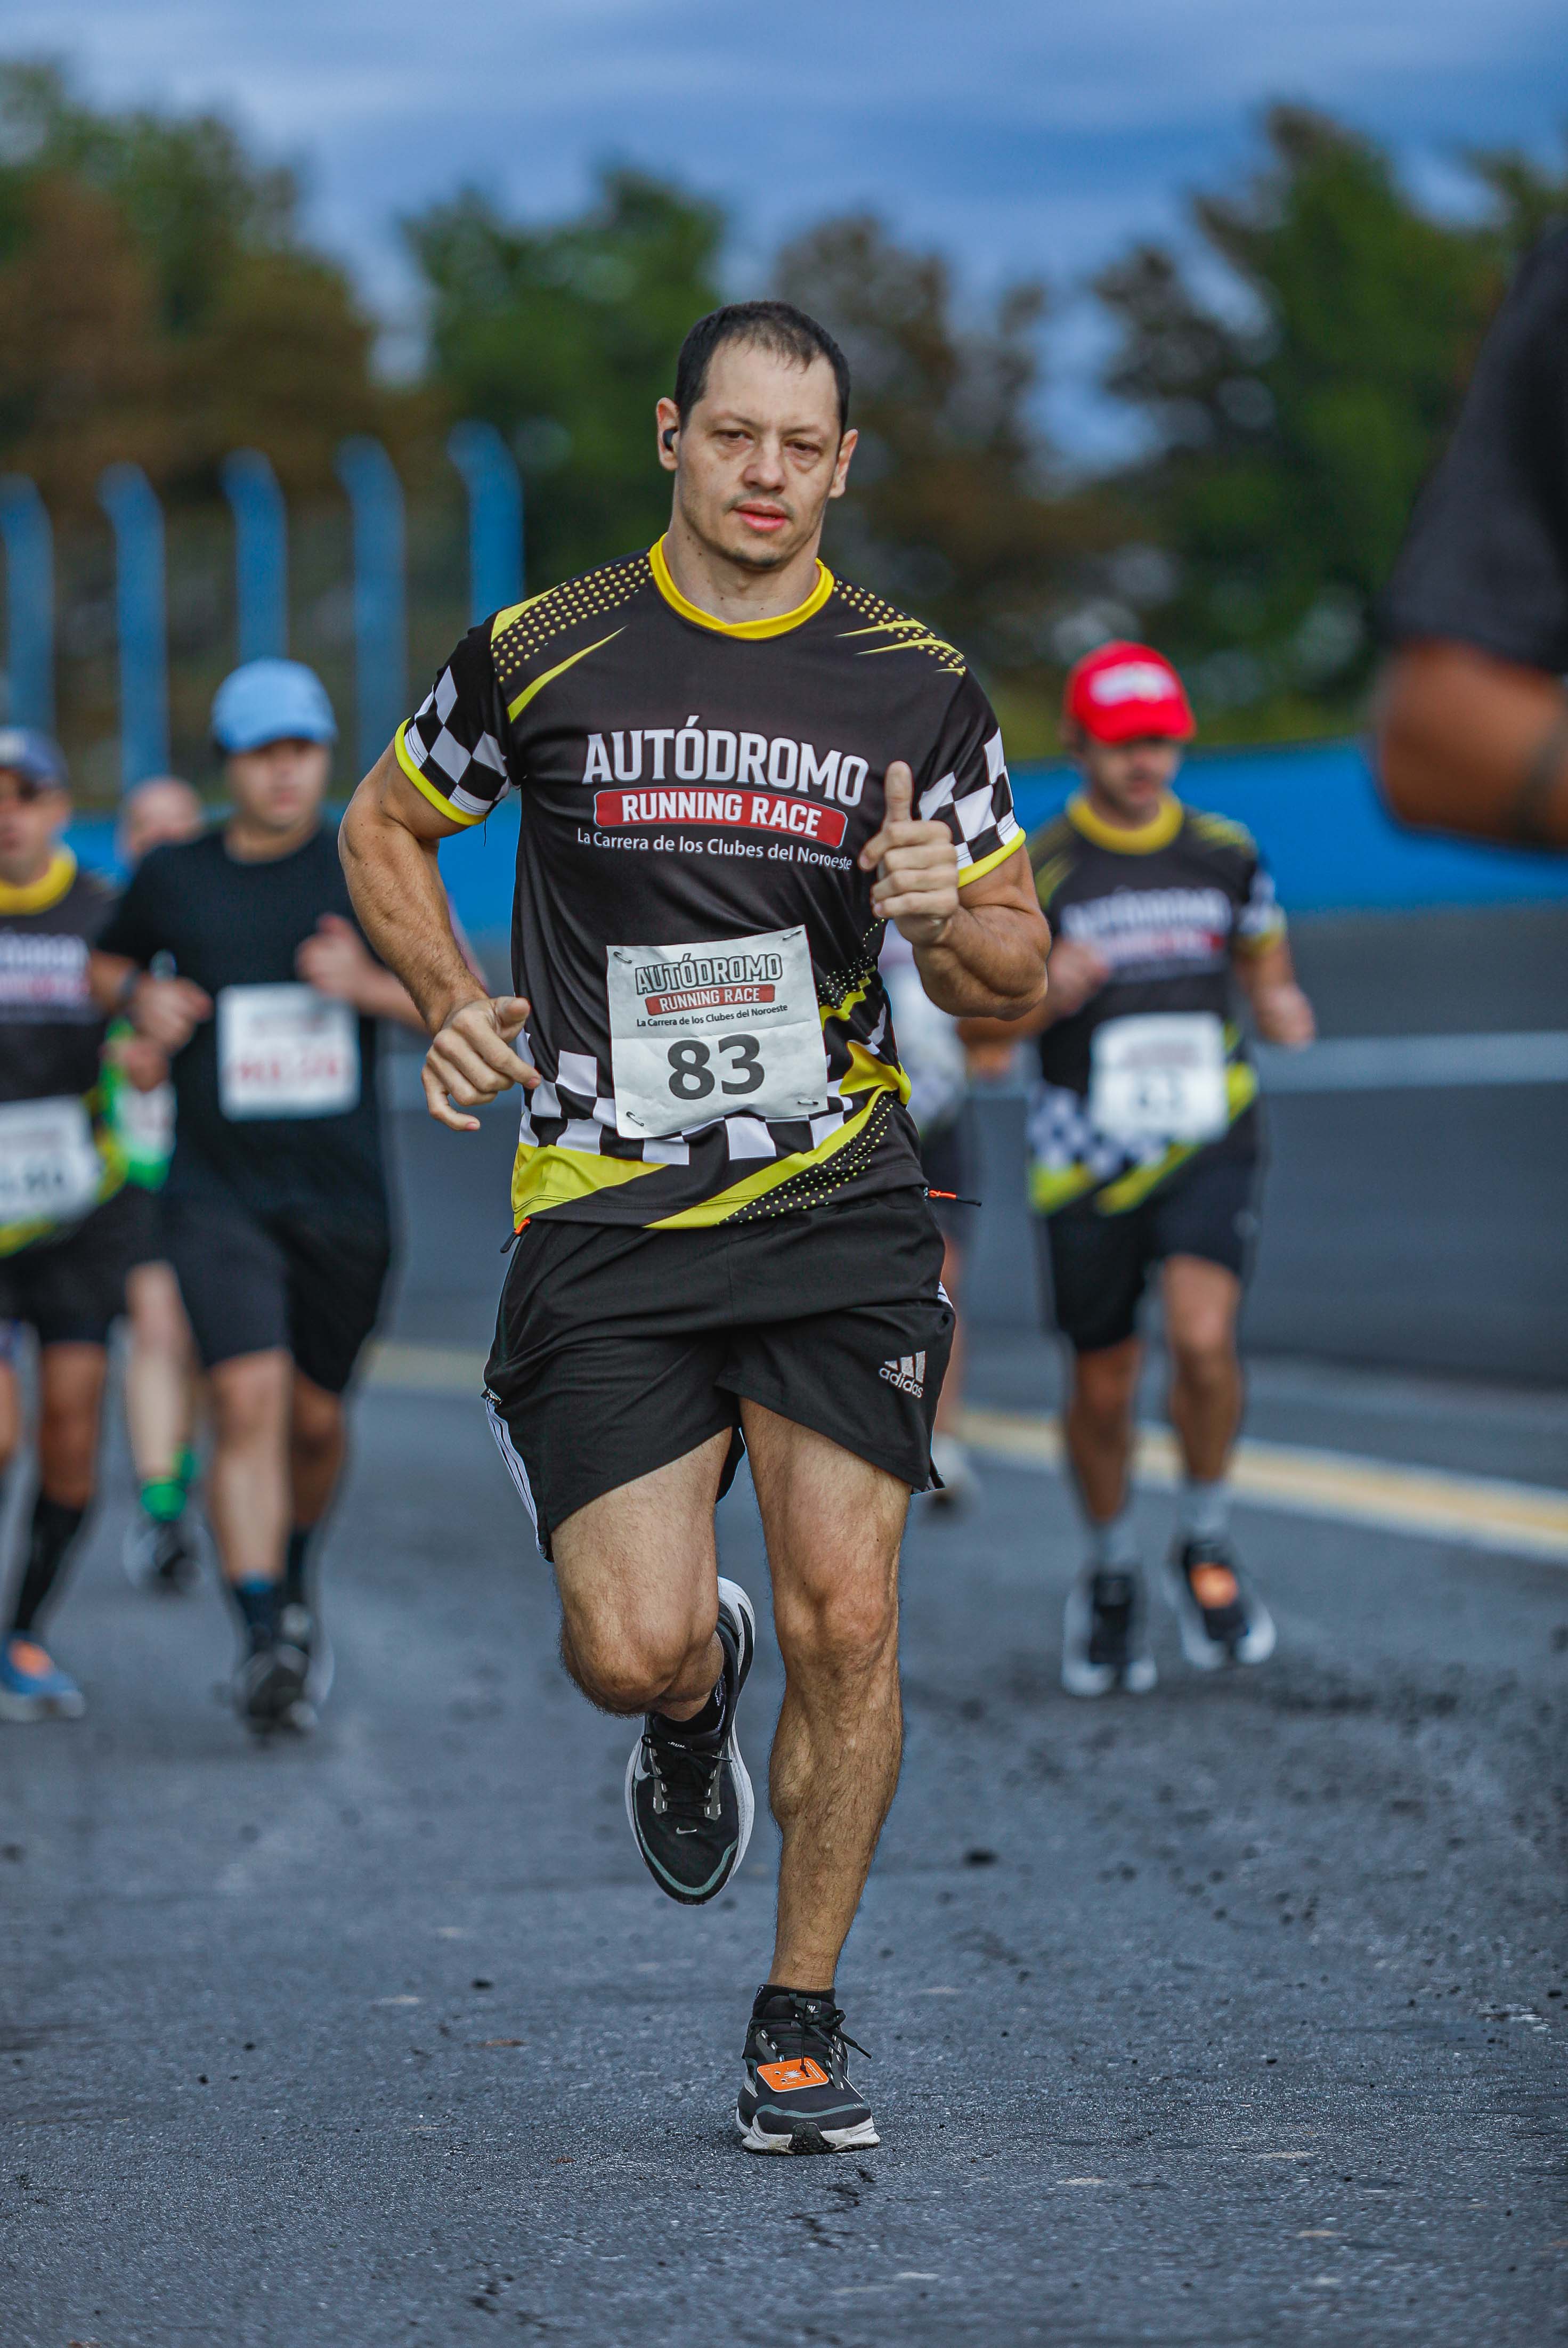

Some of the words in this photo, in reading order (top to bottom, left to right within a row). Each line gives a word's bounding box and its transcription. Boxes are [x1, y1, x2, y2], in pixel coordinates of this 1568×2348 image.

[582, 715, 870, 807] AUTÓDROMO
[621, 792, 742, 822] RUNNING
[751, 796, 822, 837] RACE
[578, 827, 591, 844] La
[593, 832, 648, 851] Carrera
[653, 835, 675, 851] de
[679, 835, 703, 854] los
[707, 838, 764, 858] Clubes
[768, 843, 794, 862] del
[797, 847, 852, 870] Noroeste
[635, 953, 783, 995] AUTÓDROMO
[659, 989, 719, 1012] RUNNING
[724, 987, 760, 1002] RACE
[706, 1013, 734, 1022] Clubes
[736, 1009, 749, 1019] del
[751, 1004, 788, 1016] Noroeste
[668, 1034, 765, 1100] 83
[879, 1368, 923, 1398] adidas
